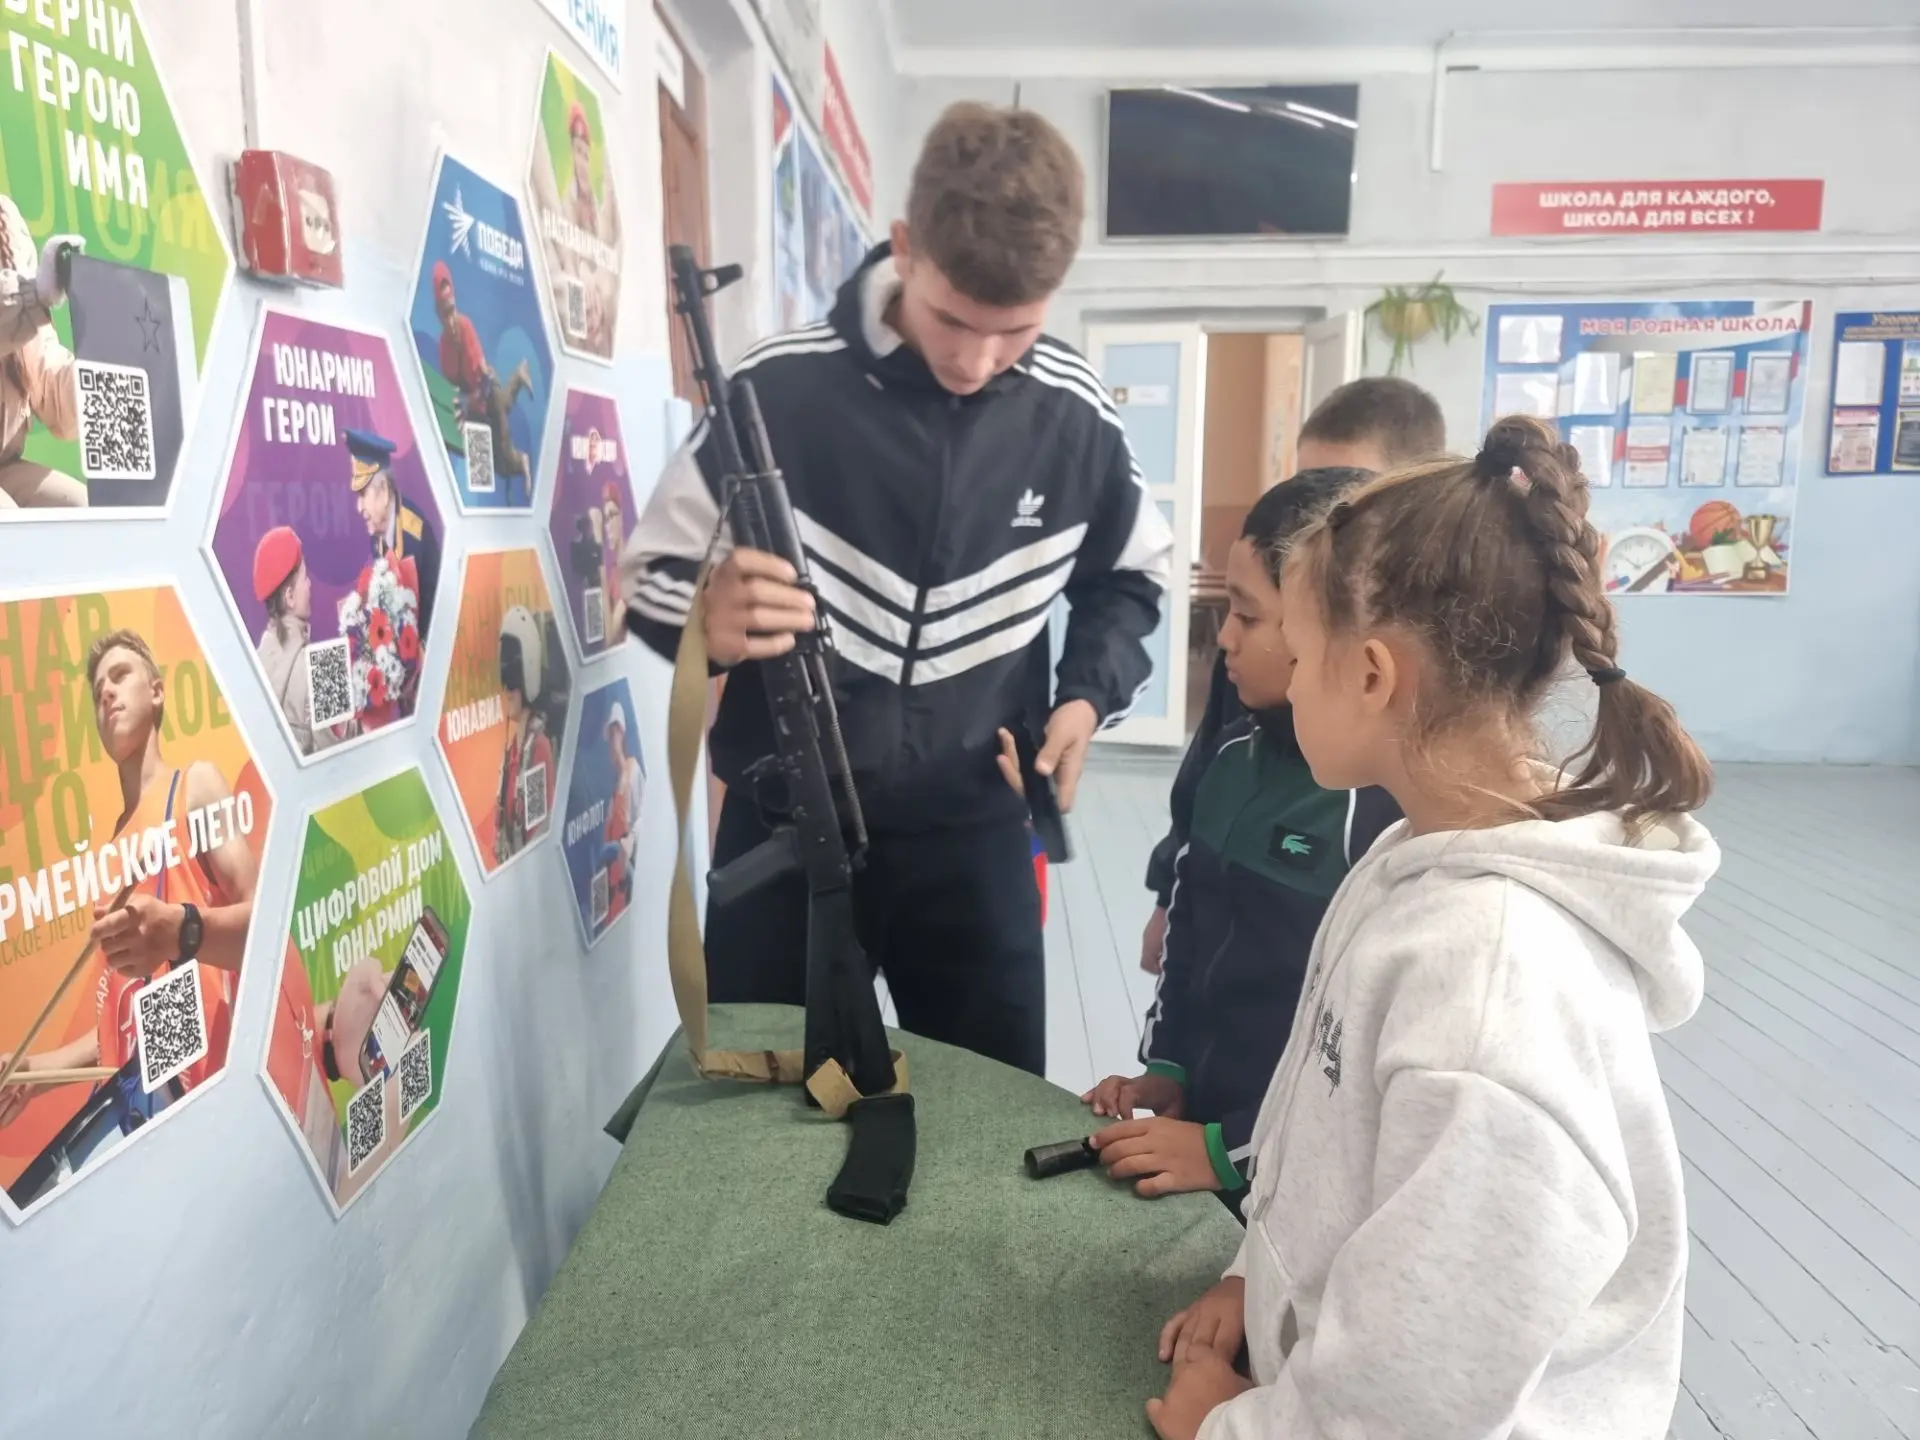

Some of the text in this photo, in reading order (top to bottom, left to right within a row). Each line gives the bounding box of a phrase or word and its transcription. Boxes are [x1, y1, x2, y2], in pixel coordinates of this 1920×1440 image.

[4, 0, 136, 68] ЕРНИ
[8, 29, 142, 137] ГЕРОЮ
[64, 127, 149, 210] ИМЯ
[1539, 188, 1776, 208] ШКОЛА ДЛЯ КАЖДОГО,
[1562, 211, 1640, 227] ШКОЛА
[1642, 210, 1686, 228] ДЛЯ
[1690, 210, 1744, 225] ВСЕХ
[476, 219, 525, 271] ПОБЕДА
[1580, 315, 1798, 336] МОЯ РОДНАЯ ШКОЛА
[272, 341, 377, 399] ЮНАРМИЯ
[261, 395, 337, 447] ГЕРОИ
[188, 790, 254, 858] ЛЕТО
[297, 844, 404, 952] ЦИФРОВОЙ
[407, 829, 442, 885] ДОМ
